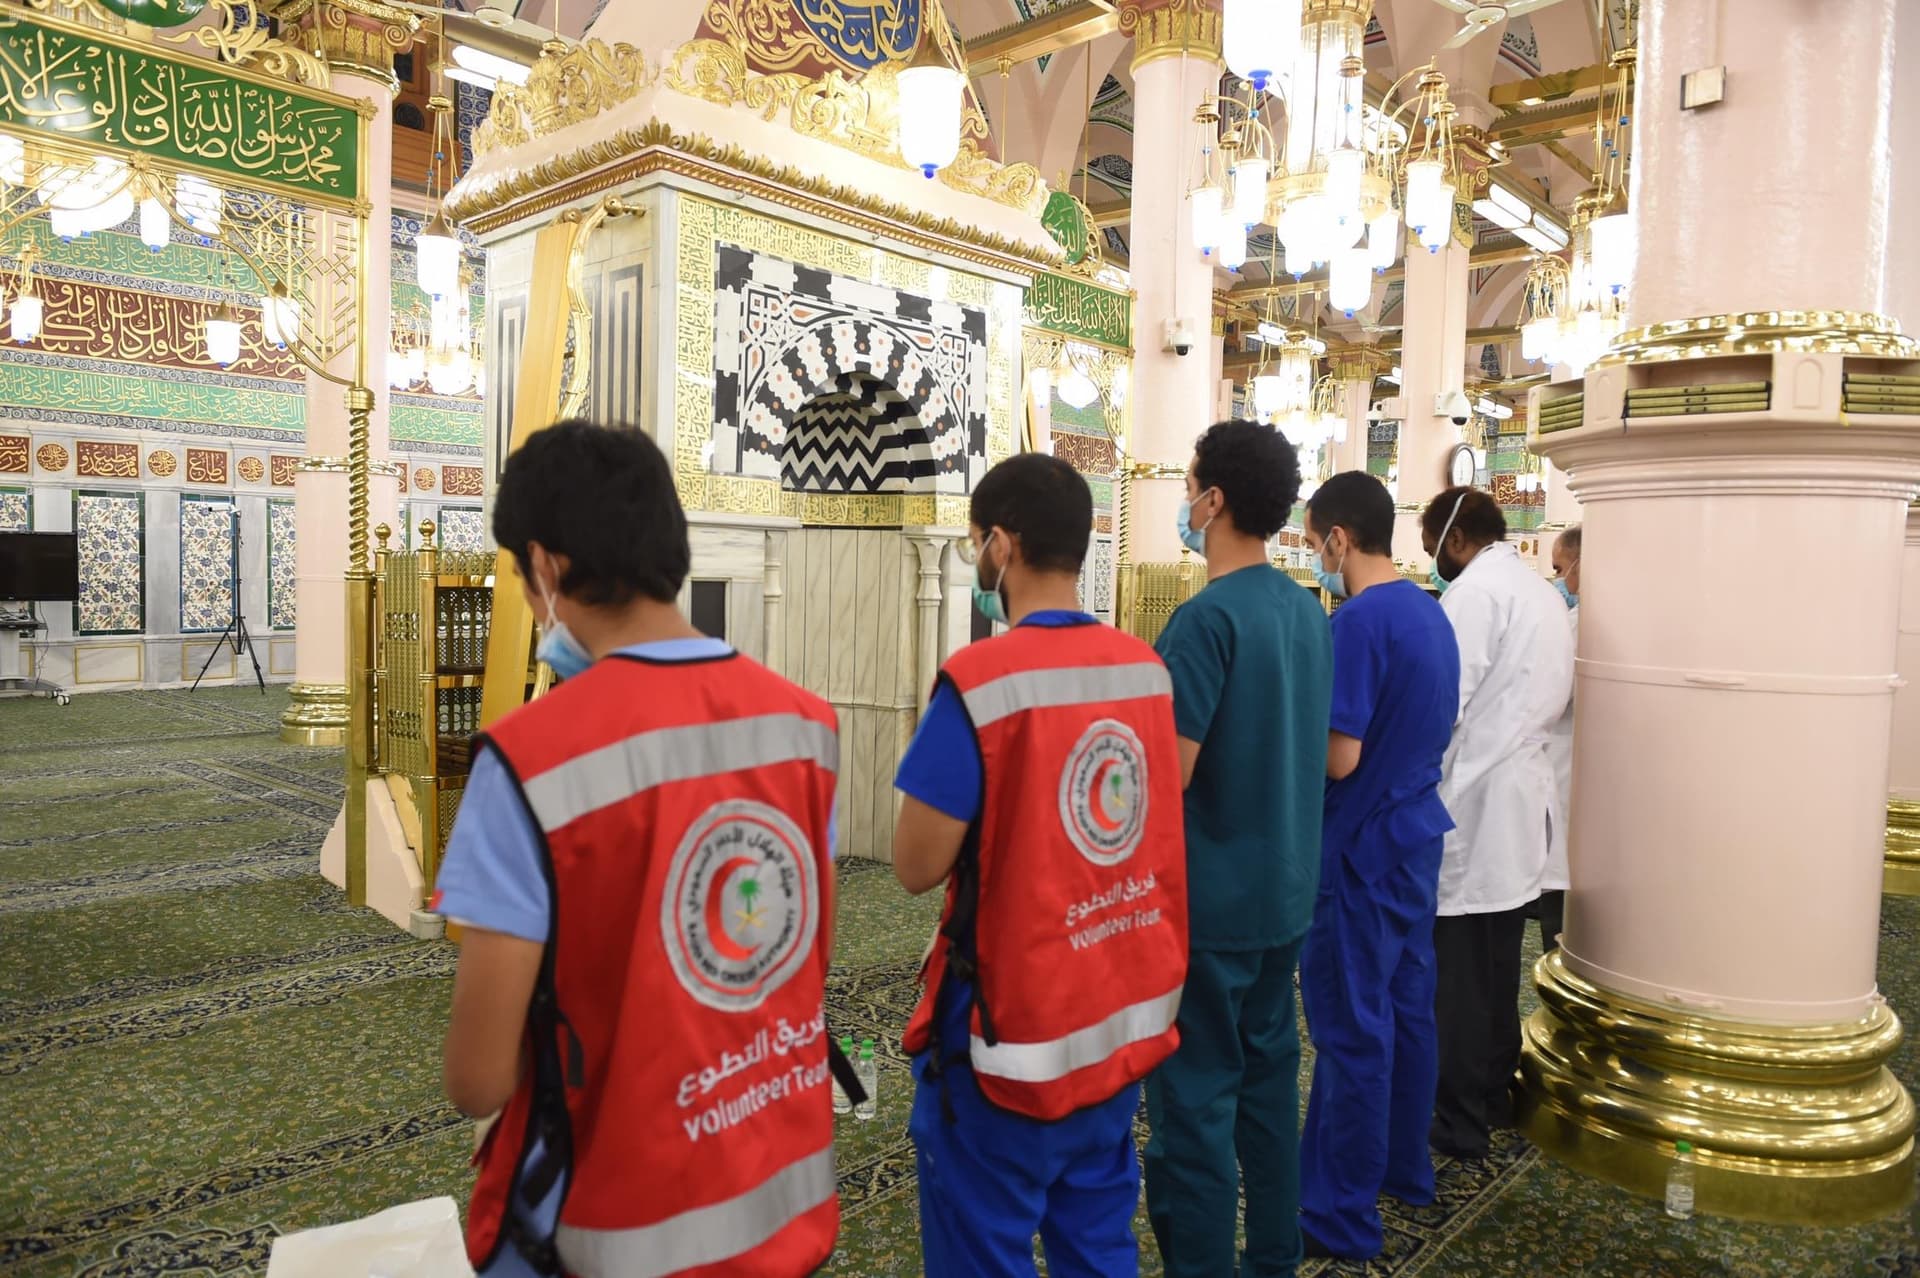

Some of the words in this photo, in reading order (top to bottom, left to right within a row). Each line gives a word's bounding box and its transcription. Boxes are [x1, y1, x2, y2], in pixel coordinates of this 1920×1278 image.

[232, 94, 315, 169] رسول
[284, 146, 342, 184] محمد
[1065, 881, 1122, 928] التطوع
[1122, 868, 1156, 902] فريق
[676, 1028, 769, 1108] التطوع
